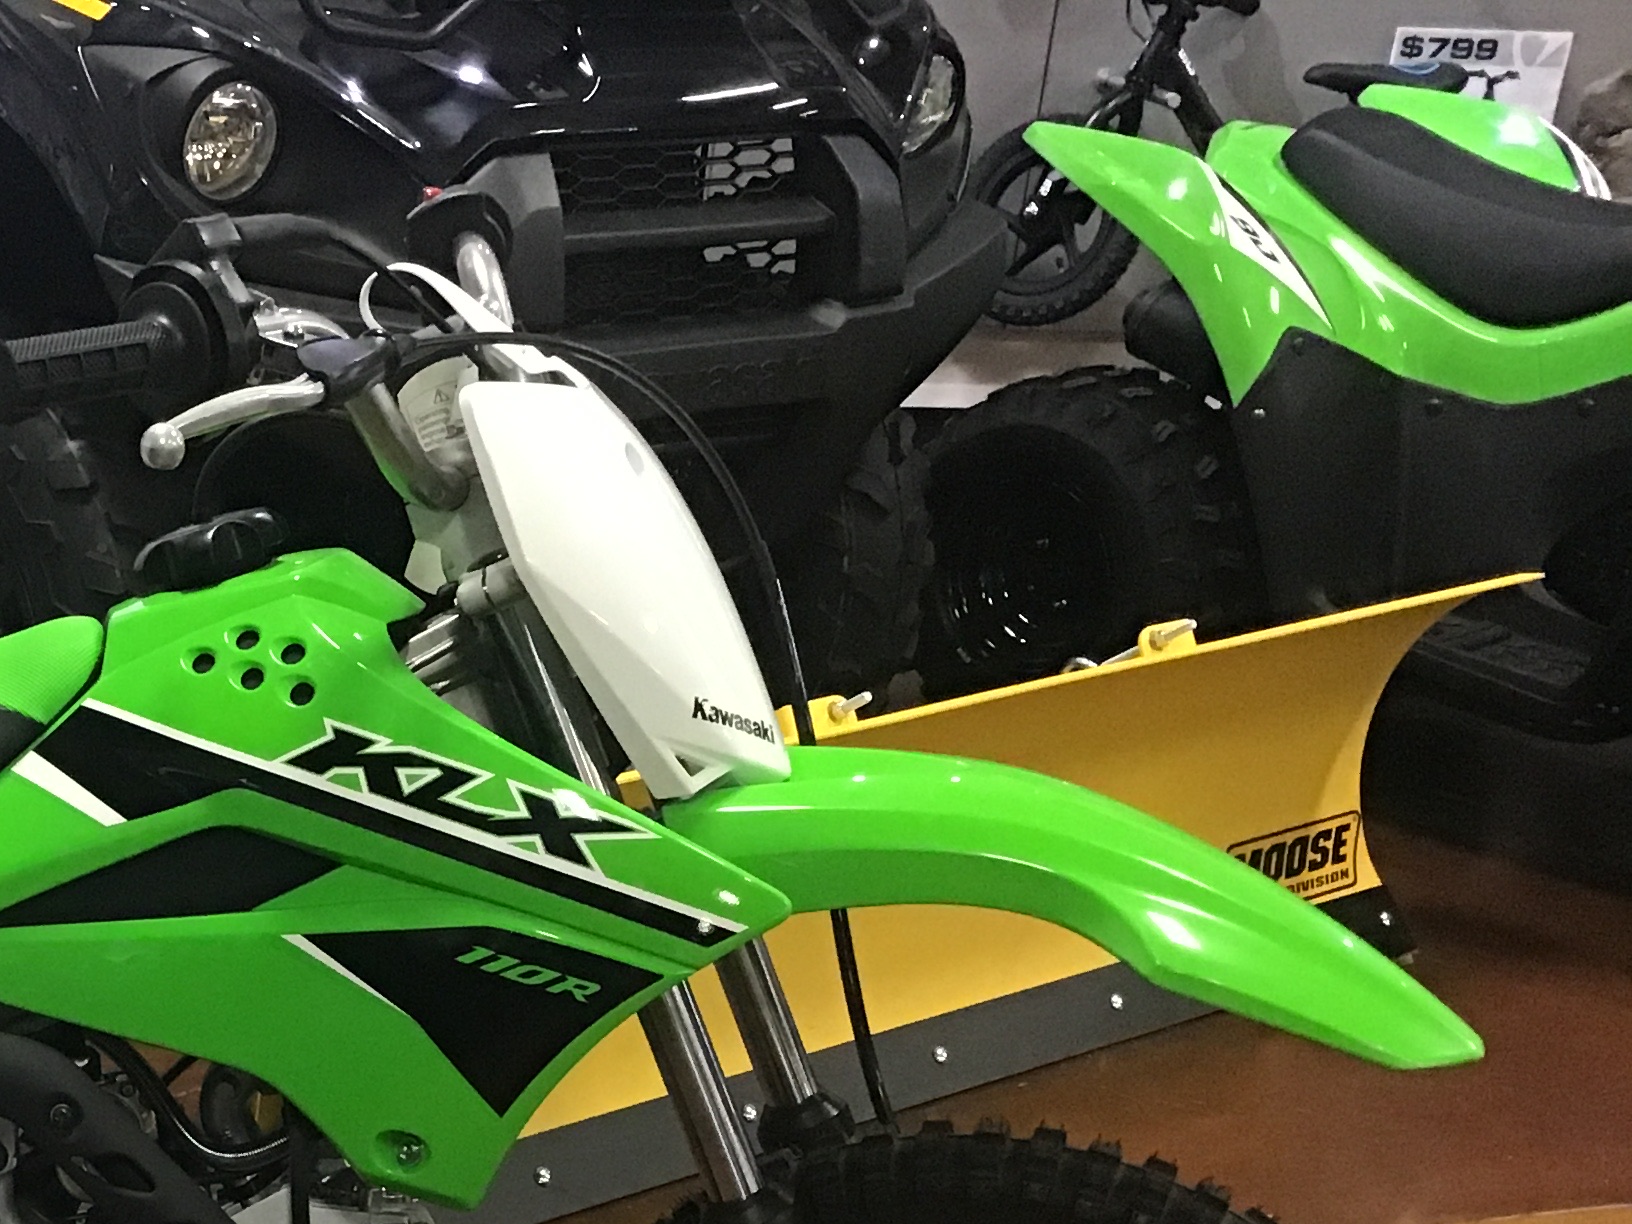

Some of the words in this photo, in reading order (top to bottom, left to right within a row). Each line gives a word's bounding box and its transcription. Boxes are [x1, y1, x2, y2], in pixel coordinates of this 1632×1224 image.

[1400, 35, 1499, 60] $799
[692, 696, 775, 744] Kawasaki
[271, 718, 662, 876] KLX
[455, 945, 602, 1003] 110R
